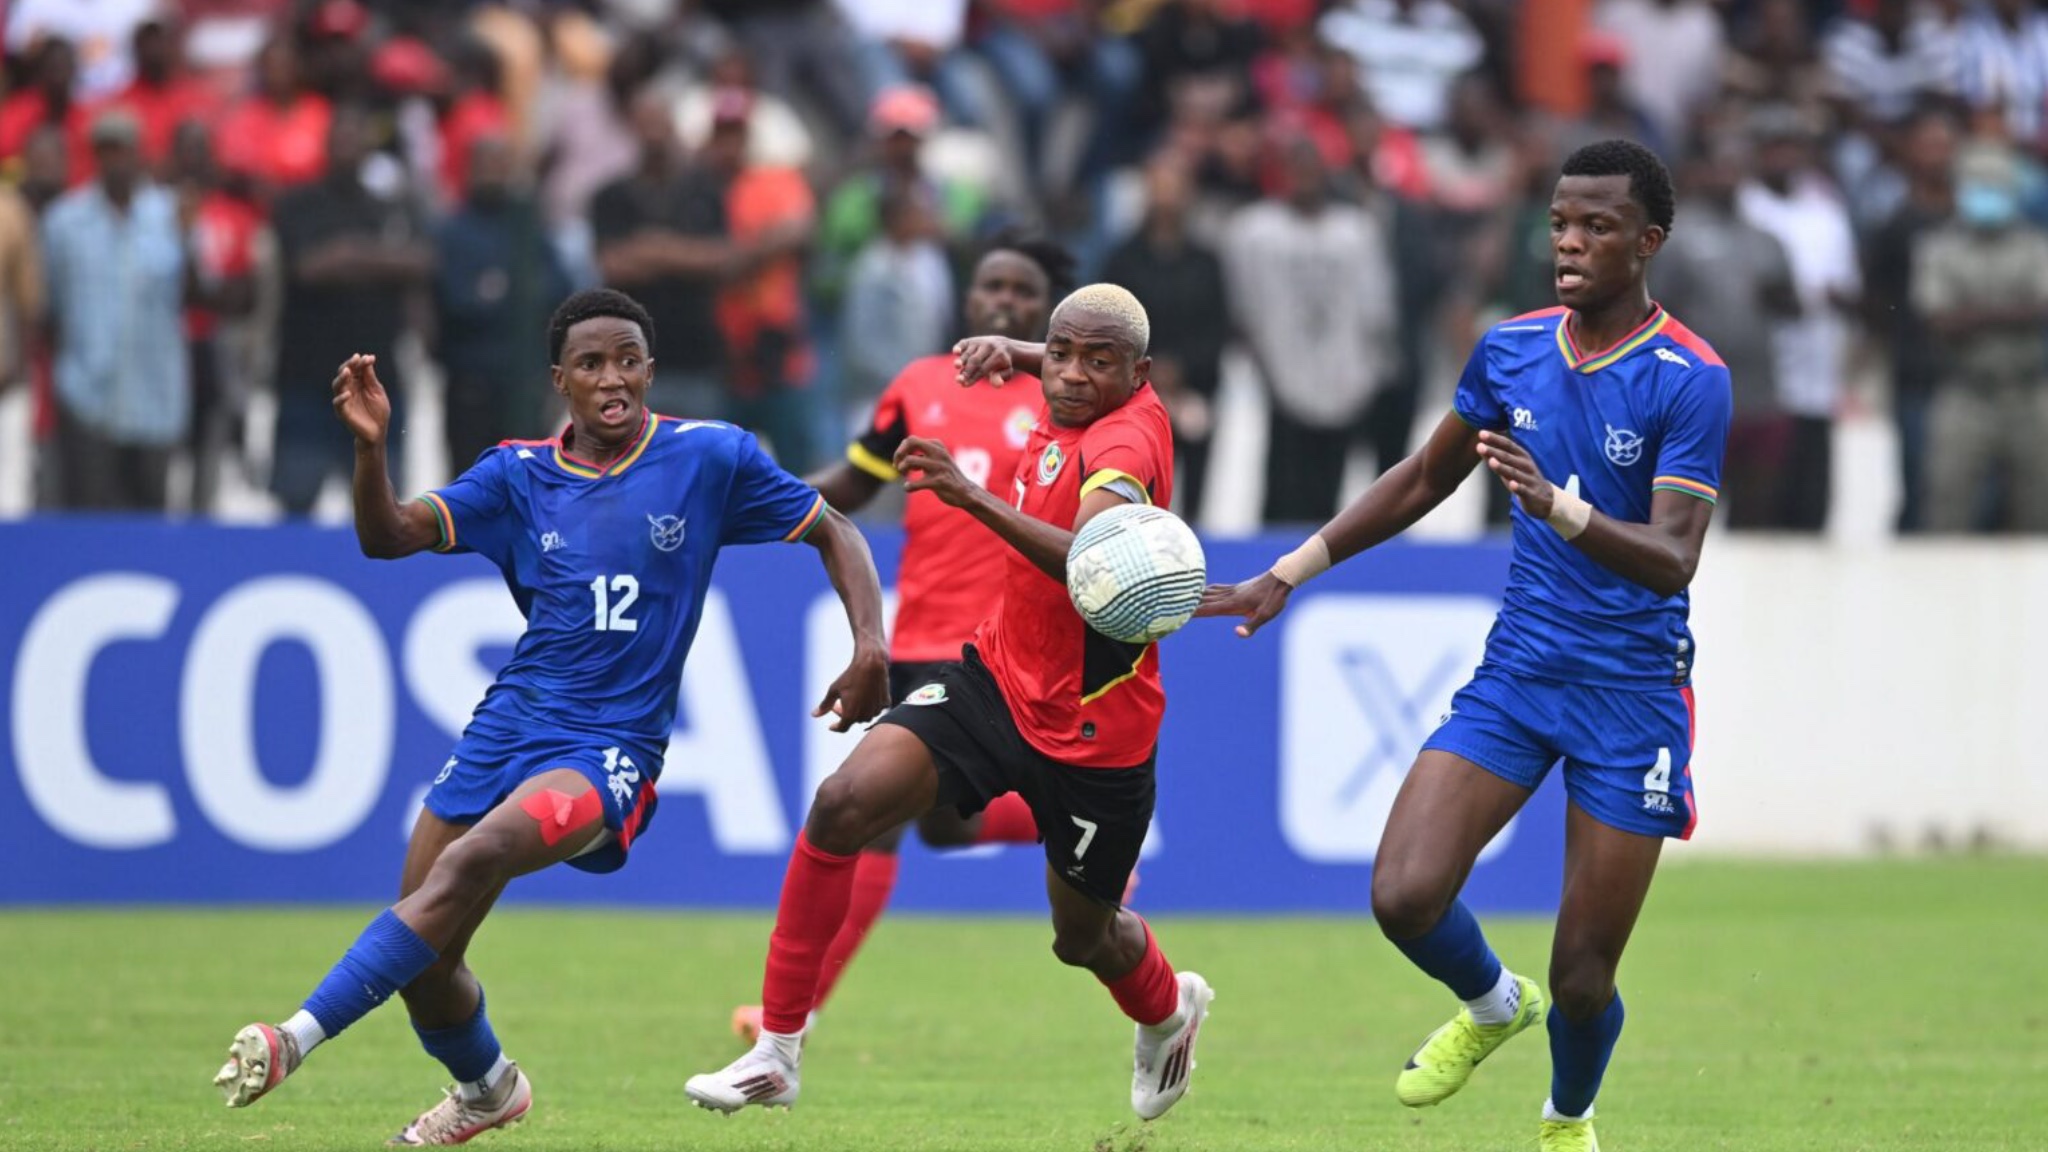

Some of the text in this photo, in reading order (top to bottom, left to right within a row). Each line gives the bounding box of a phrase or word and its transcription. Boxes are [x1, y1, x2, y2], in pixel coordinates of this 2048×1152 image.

[590, 574, 640, 631] 12
[601, 746, 640, 800] 12
[1644, 746, 1672, 792] 4
[1070, 814, 1098, 861] 7
